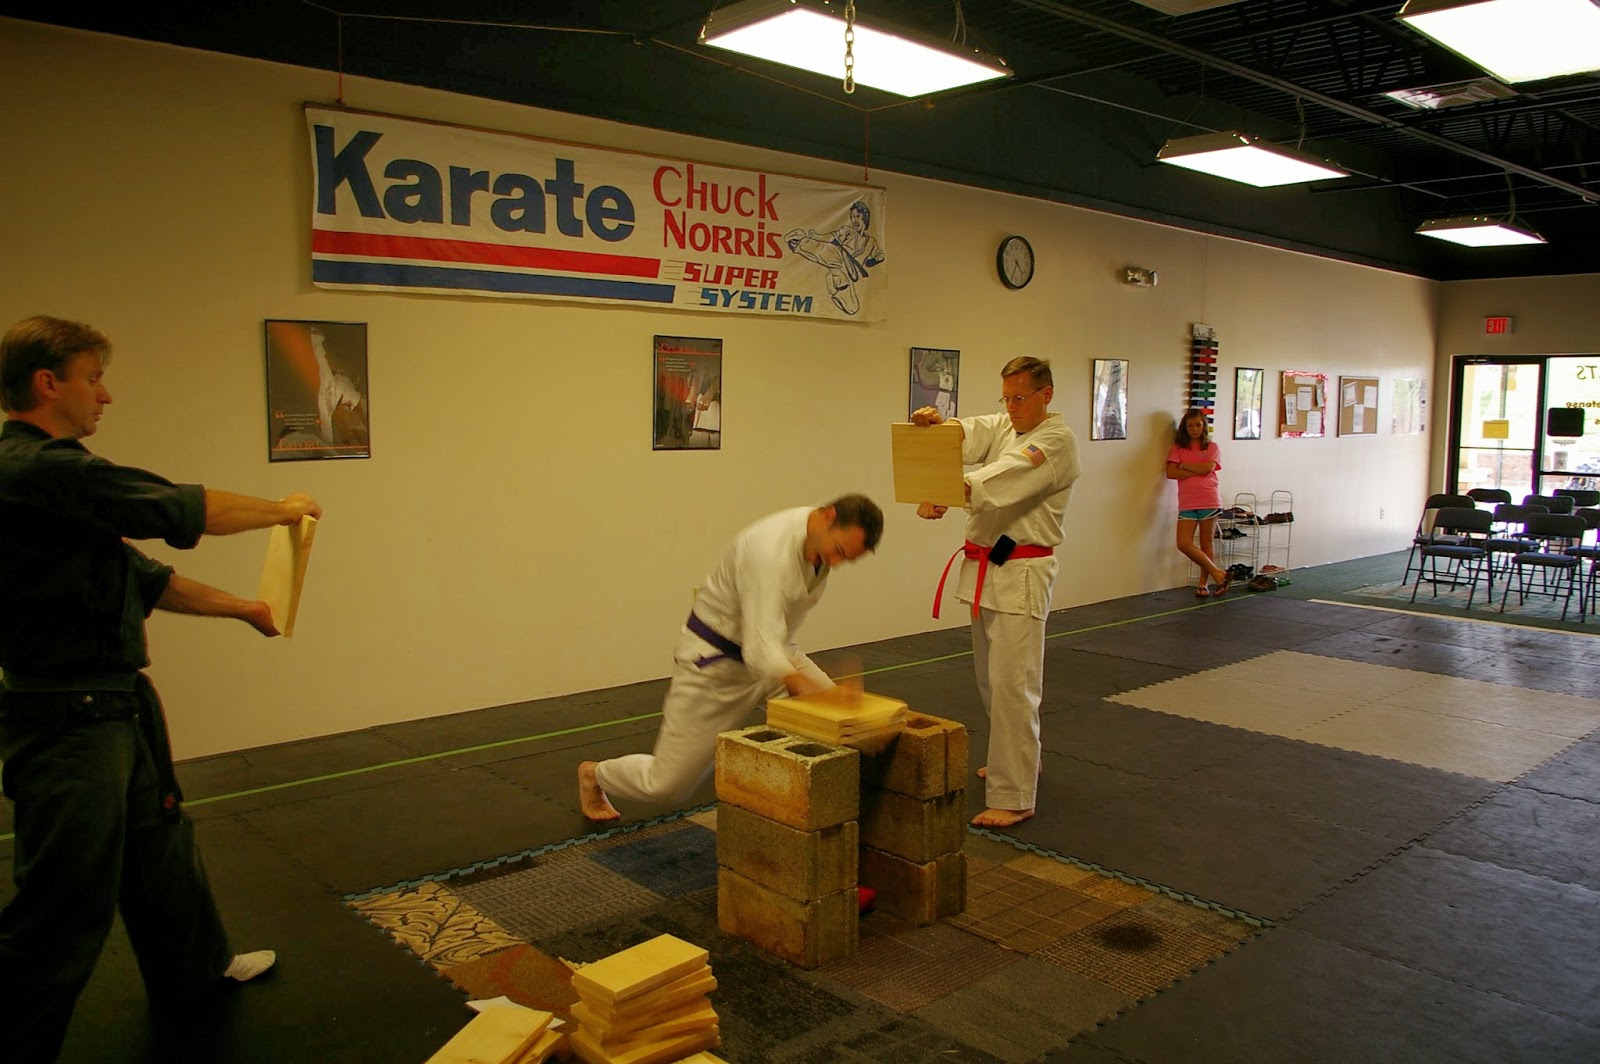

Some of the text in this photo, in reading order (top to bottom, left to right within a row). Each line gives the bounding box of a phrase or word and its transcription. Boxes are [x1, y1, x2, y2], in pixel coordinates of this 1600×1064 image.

[314, 124, 635, 242] Karate
[682, 262, 779, 289] SUPER
[700, 287, 813, 313] SYSTEM
[1486, 318, 1507, 334] EXIT
